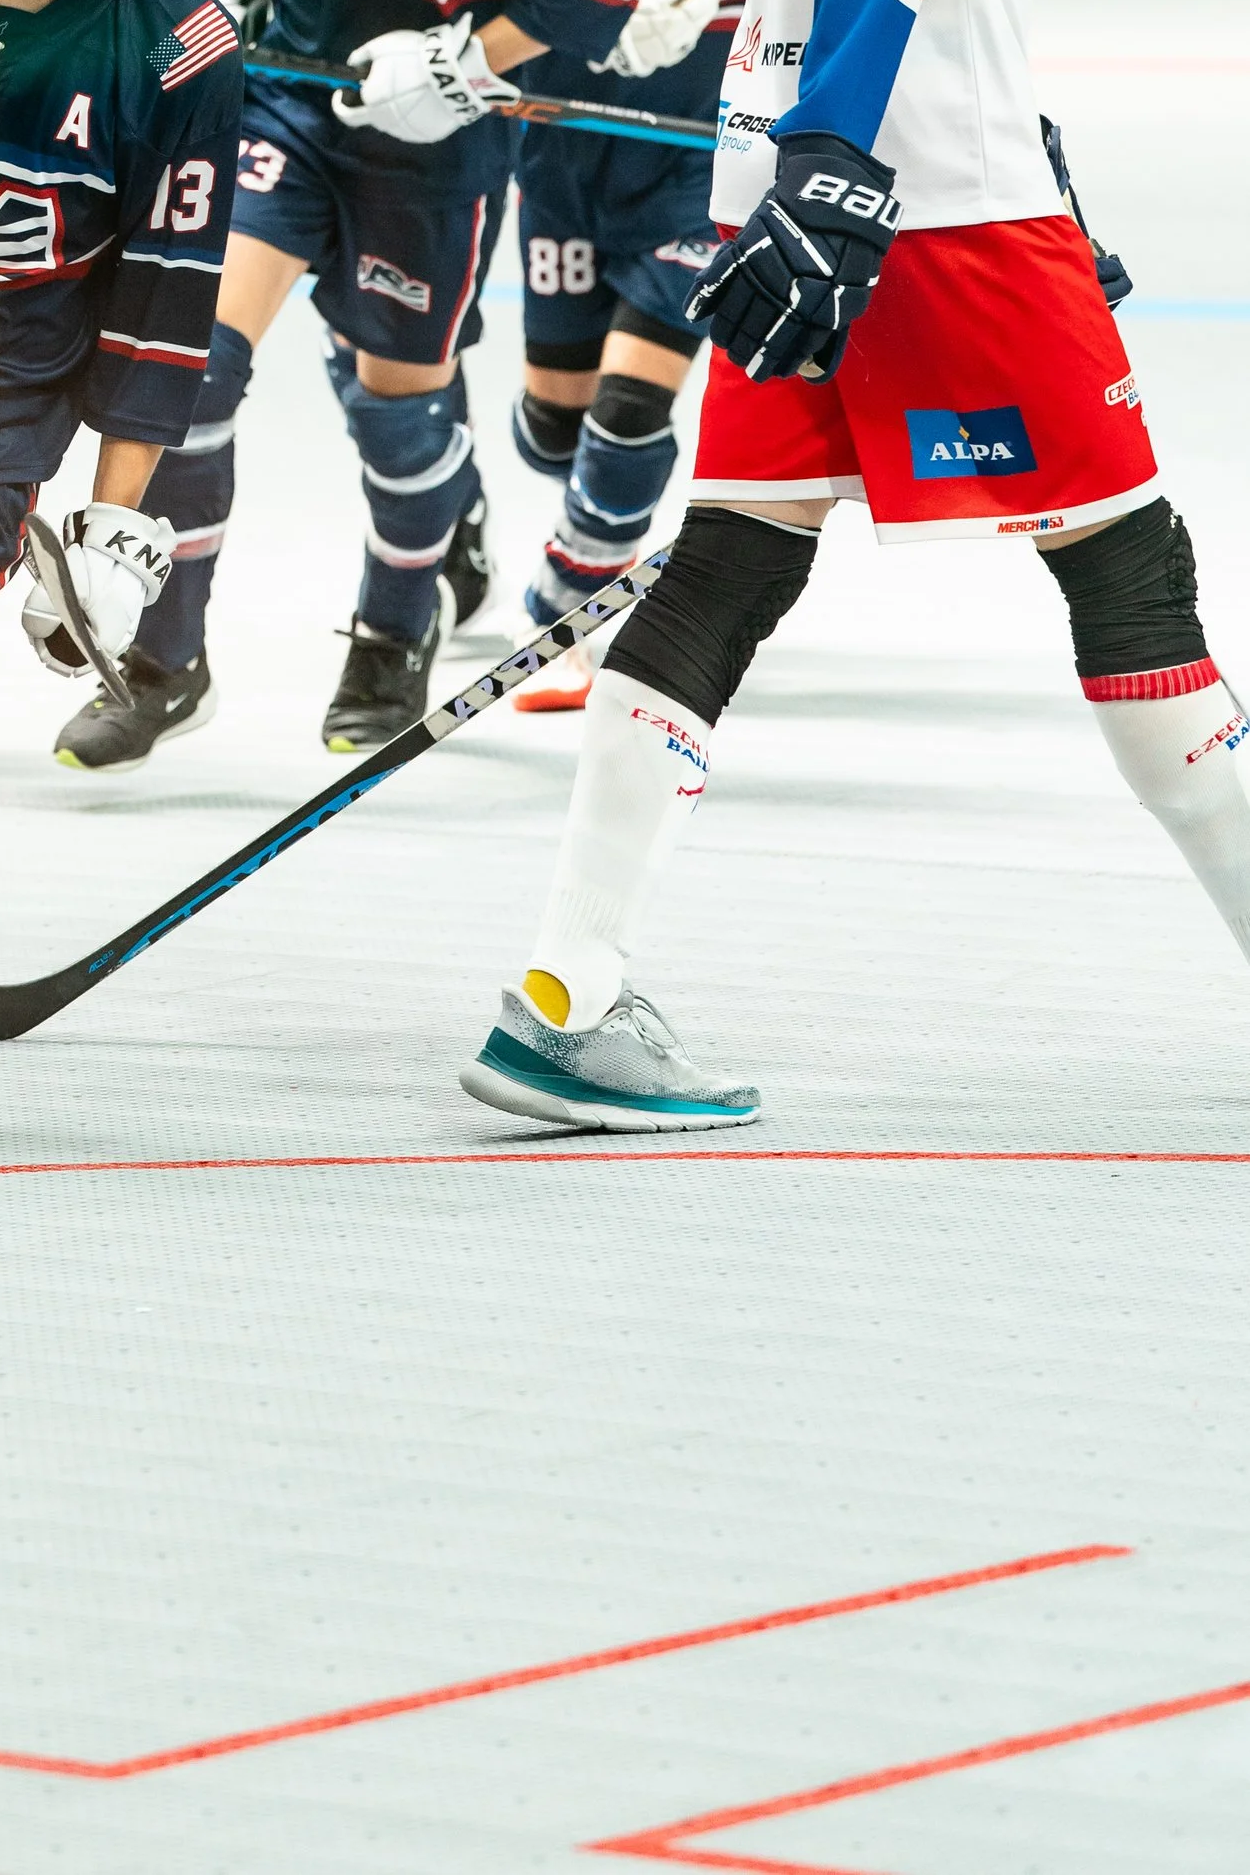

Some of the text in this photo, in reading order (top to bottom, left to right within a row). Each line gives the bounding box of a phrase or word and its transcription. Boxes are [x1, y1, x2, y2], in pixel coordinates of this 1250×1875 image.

[55, 92, 94, 151] A
[720, 135, 753, 155] group
[149, 156, 217, 233] 13
[528, 236, 596, 296] 88
[929, 441, 1015, 461] ALPA
[997, 516, 1064, 534] MERCH#53
[630, 708, 701, 755] CZECH
